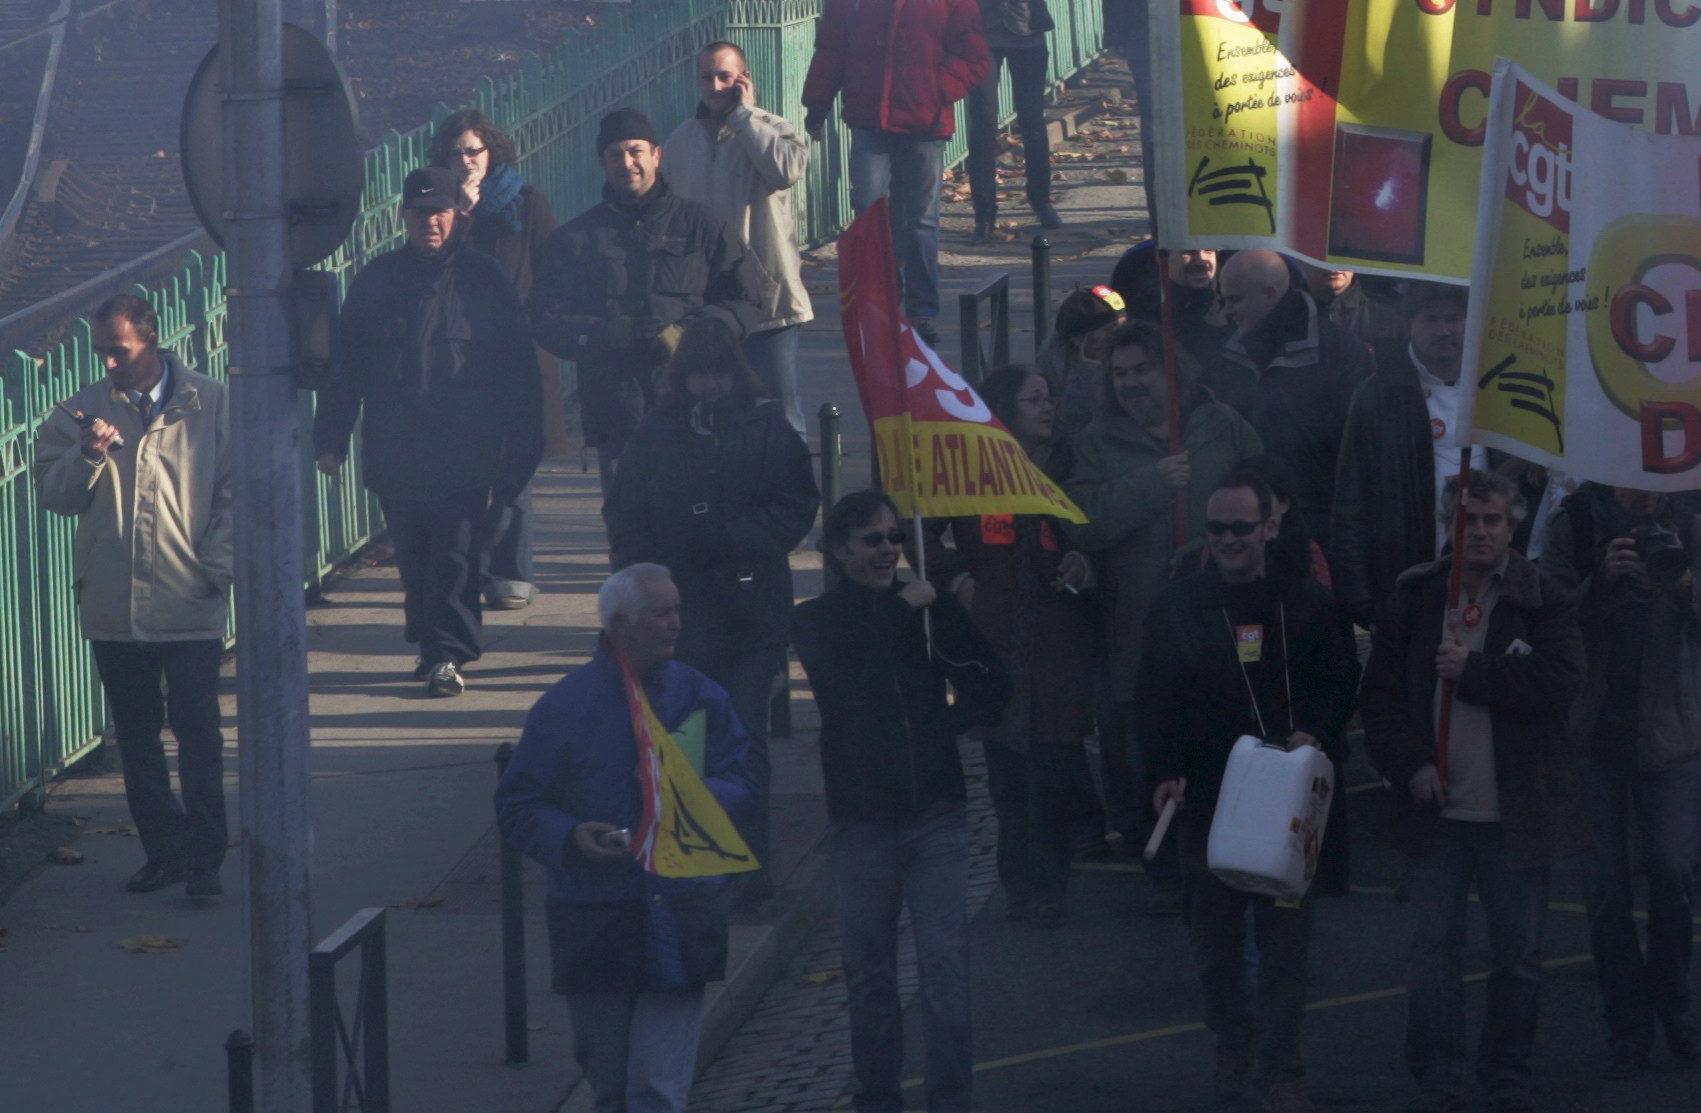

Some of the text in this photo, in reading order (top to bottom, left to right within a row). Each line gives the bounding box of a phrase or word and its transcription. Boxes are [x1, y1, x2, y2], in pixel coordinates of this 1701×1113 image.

[1214, 72, 1237, 91] des
[1267, 91, 1281, 106] de
[1509, 130, 1573, 217] cgt
